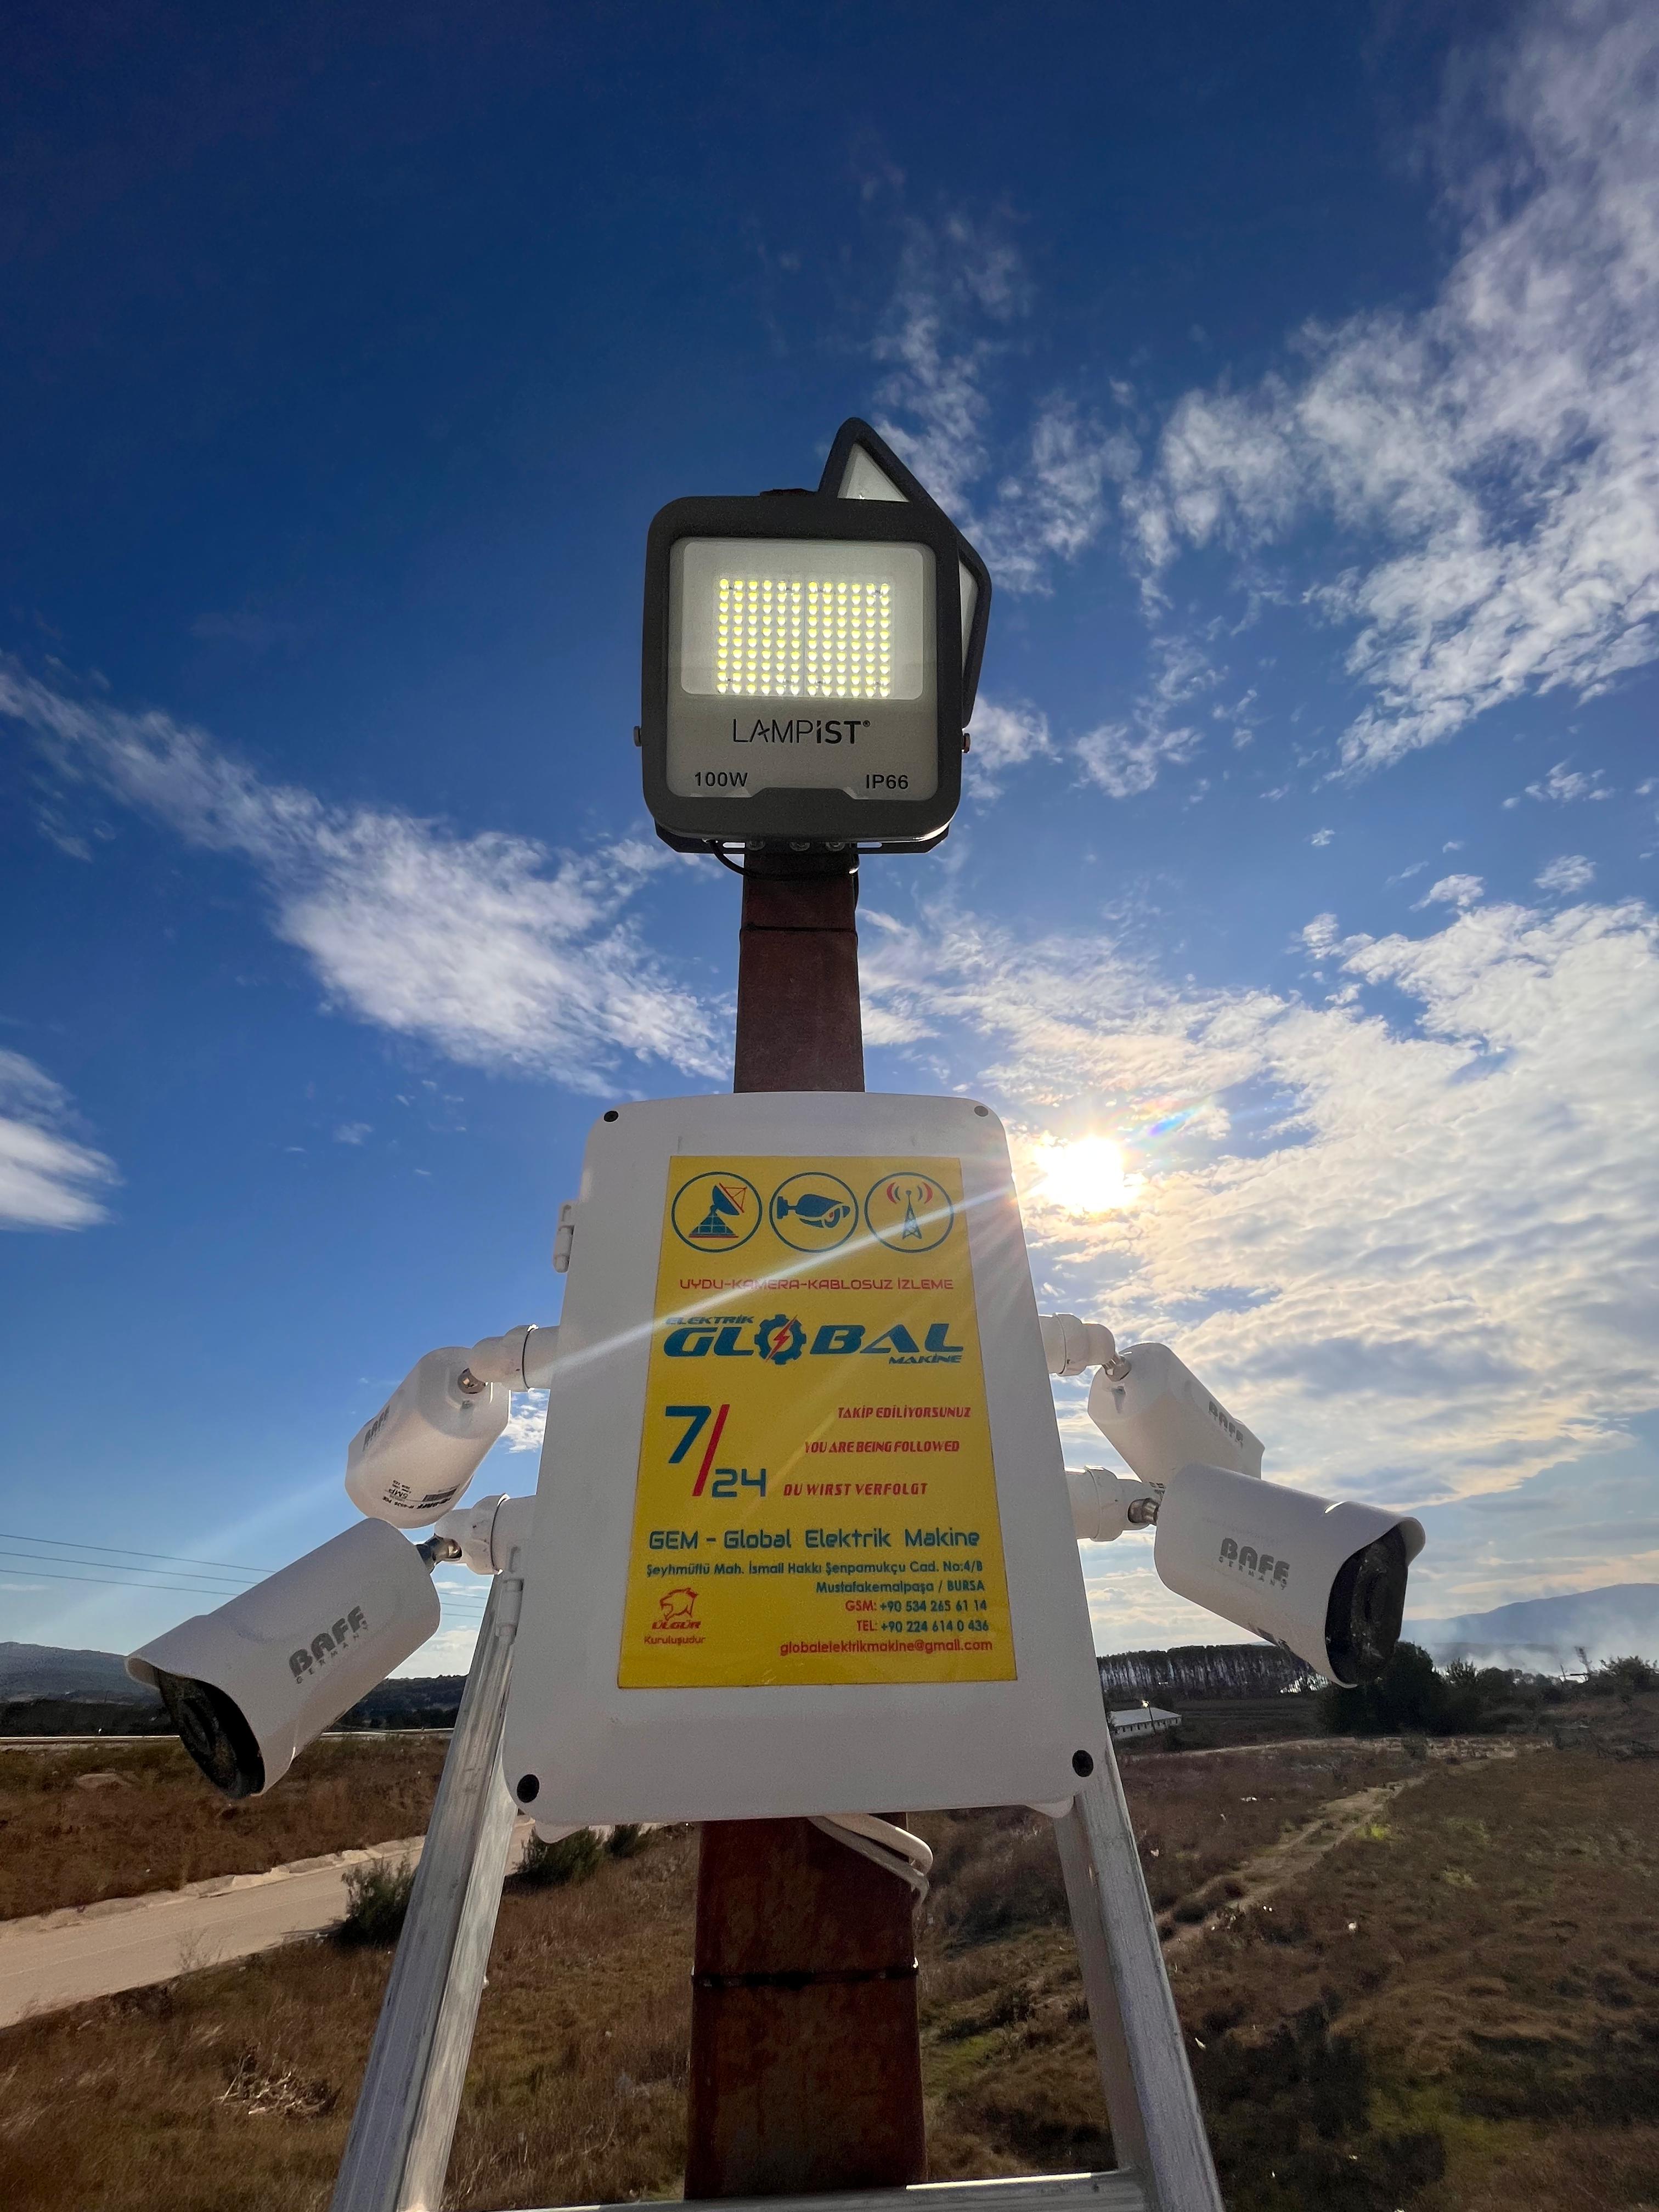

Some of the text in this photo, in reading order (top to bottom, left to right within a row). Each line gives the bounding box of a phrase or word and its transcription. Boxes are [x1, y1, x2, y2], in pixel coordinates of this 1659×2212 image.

[695, 772, 748, 787] 100W
[866, 774, 909, 789] IP66
[898, 1277, 954, 1289] İZLEME
[665, 1314, 755, 1324] ELEKTRİK
[889, 1353, 962, 1364] MAKİNE
[838, 1405, 971, 1418] TAKİP EDİLİYORSUNUZ
[805, 1441, 960, 1453] YOU ARE BEING FOLLOWED
[783, 1483, 928, 1496] DU WIRST VERFOLGT
[649, 1530, 698, 1549] GEM
[724, 1529, 792, 1548] Global
[805, 1528, 892, 1548] Elektrik
[905, 1527, 980, 1547] Makine
[1221, 1538, 1290, 1581] BAFF
[714, 1564, 744, 1575] Mah.
[910, 1561, 939, 1572] Cad.
[816, 1581, 934, 1594] Mustafakemalpaşa
[947, 1580, 985, 1592] BURSA
[845, 1599, 988, 1612] GSM: +90 534 265 61 14
[856, 1620, 877, 1632] TEL:
[881, 1621, 903, 1633] +90
[906, 1621, 928, 1633] 224
[932, 1620, 953, 1632] 614
[968, 1620, 989, 1632] 436
[289, 1605, 364, 1677] BAFF
